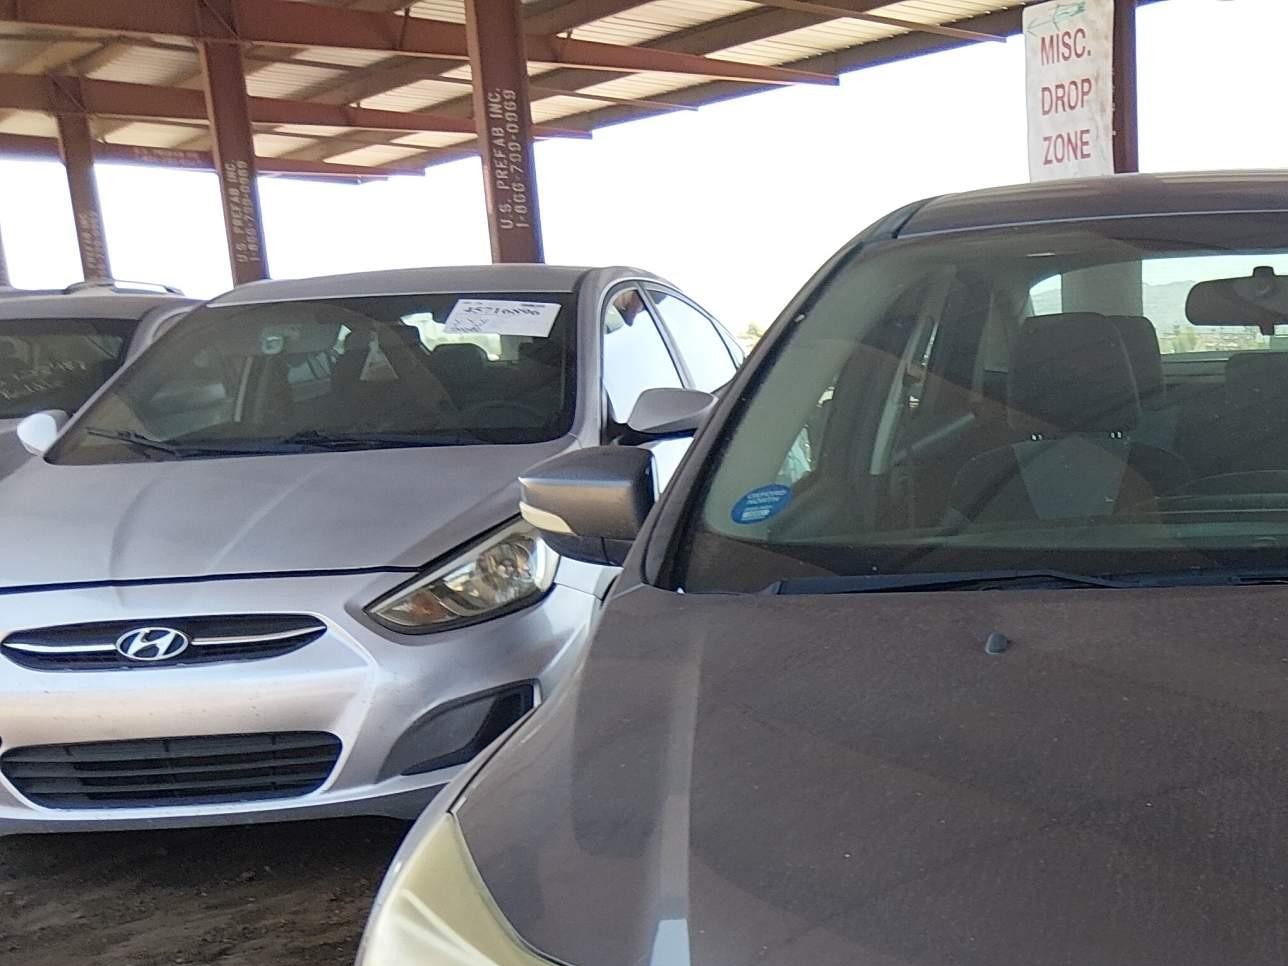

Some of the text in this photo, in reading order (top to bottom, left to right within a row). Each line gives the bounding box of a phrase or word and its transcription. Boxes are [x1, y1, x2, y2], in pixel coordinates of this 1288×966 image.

[1040, 28, 1092, 66] MISC.
[1041, 78, 1092, 116] DROP
[487, 87, 515, 230] U.S. PREFAB INC.
[1042, 129, 1092, 166] ZONE
